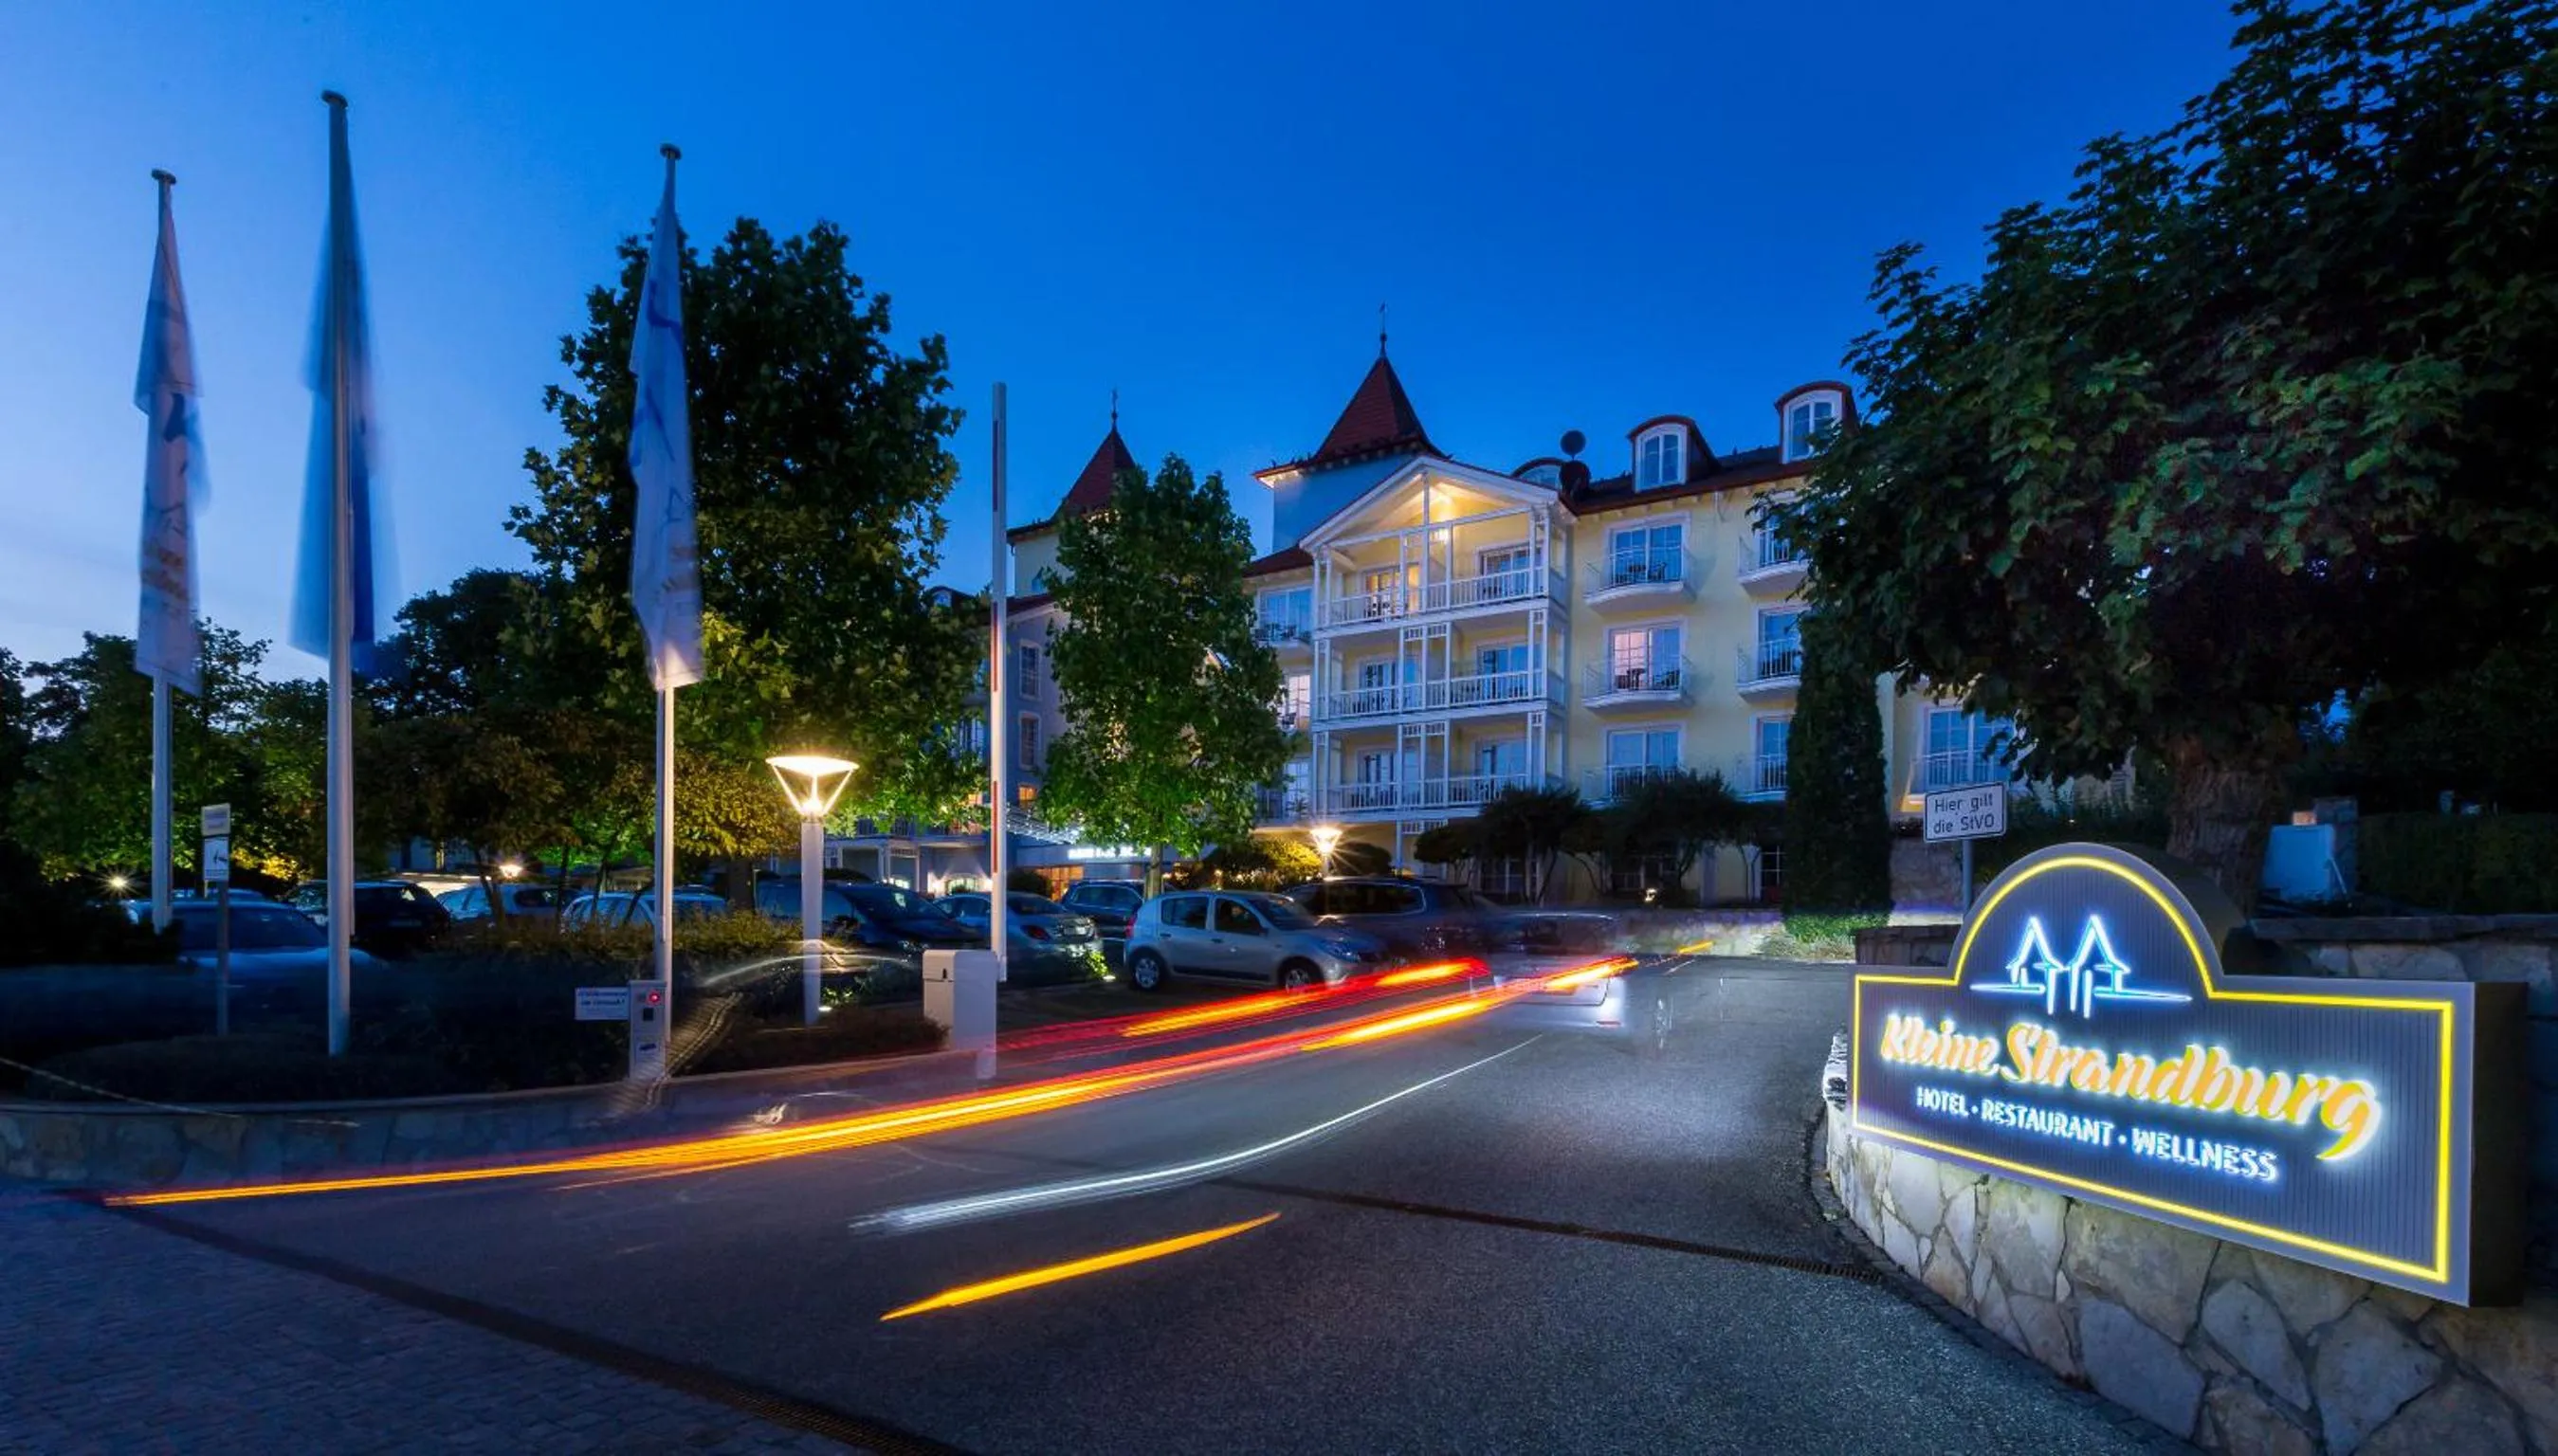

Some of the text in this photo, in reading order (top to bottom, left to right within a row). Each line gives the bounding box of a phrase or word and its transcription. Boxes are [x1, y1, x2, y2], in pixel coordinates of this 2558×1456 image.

[1933, 813, 1995, 834] die StVO
[1935, 792, 1993, 813] Hier gilt
[1881, 1012, 2382, 1160] Kleine Strandburg
[1916, 1086, 2279, 1182] HOTEL RESTAURANT WELLNESS
